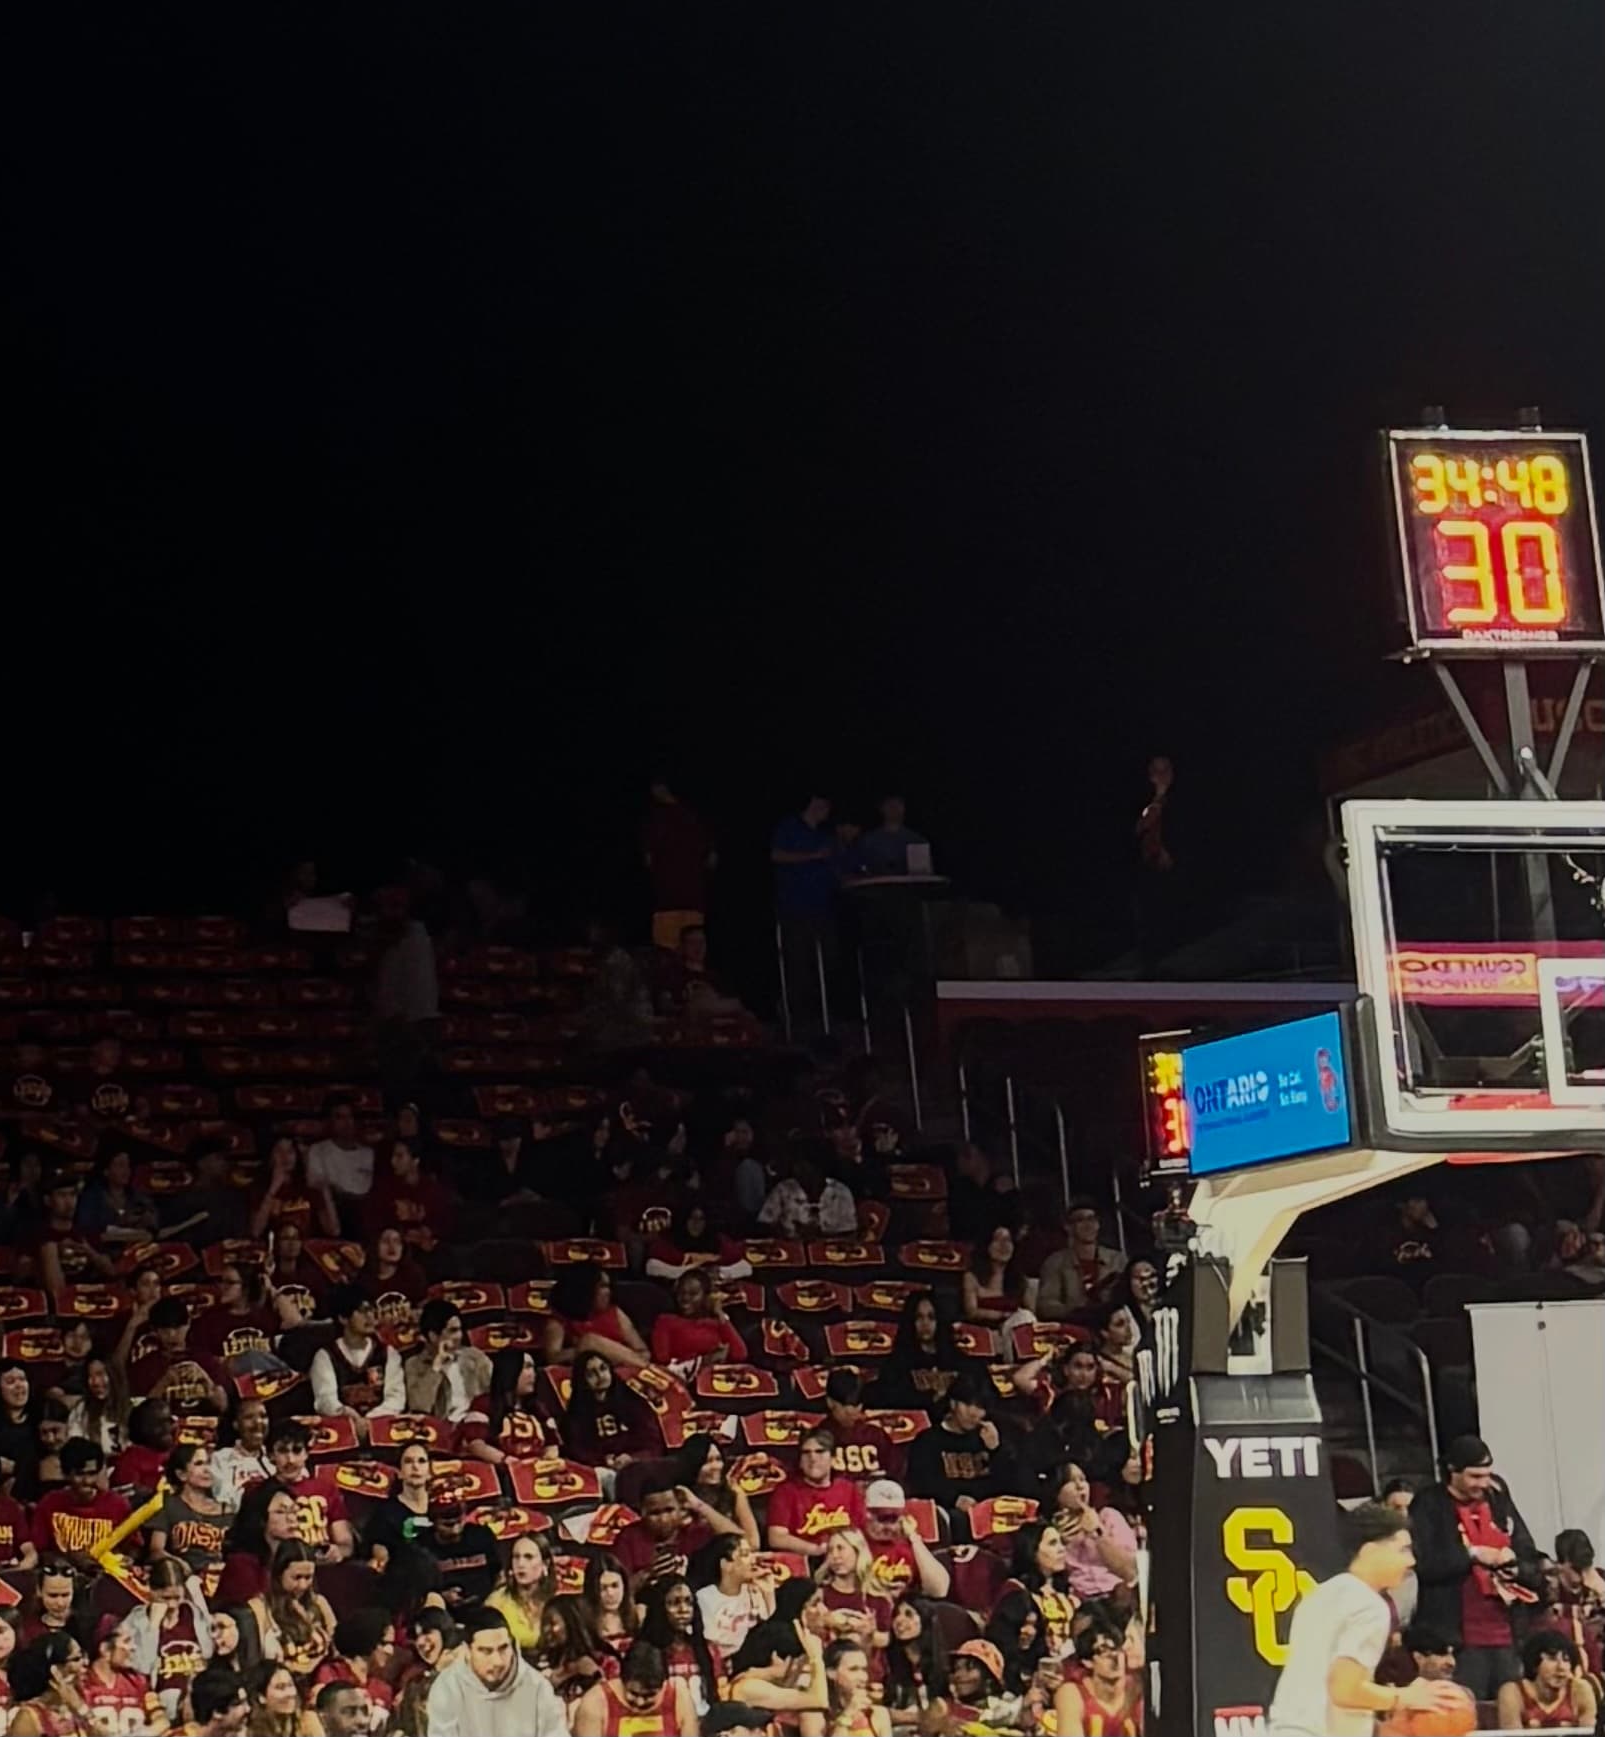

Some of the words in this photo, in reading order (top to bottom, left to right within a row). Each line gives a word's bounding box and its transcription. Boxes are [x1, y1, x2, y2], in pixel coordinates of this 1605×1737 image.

[1412, 454, 1570, 514] 34:48
[1437, 519, 1567, 624] 30
[1202, 1435, 1322, 1478] YETI
